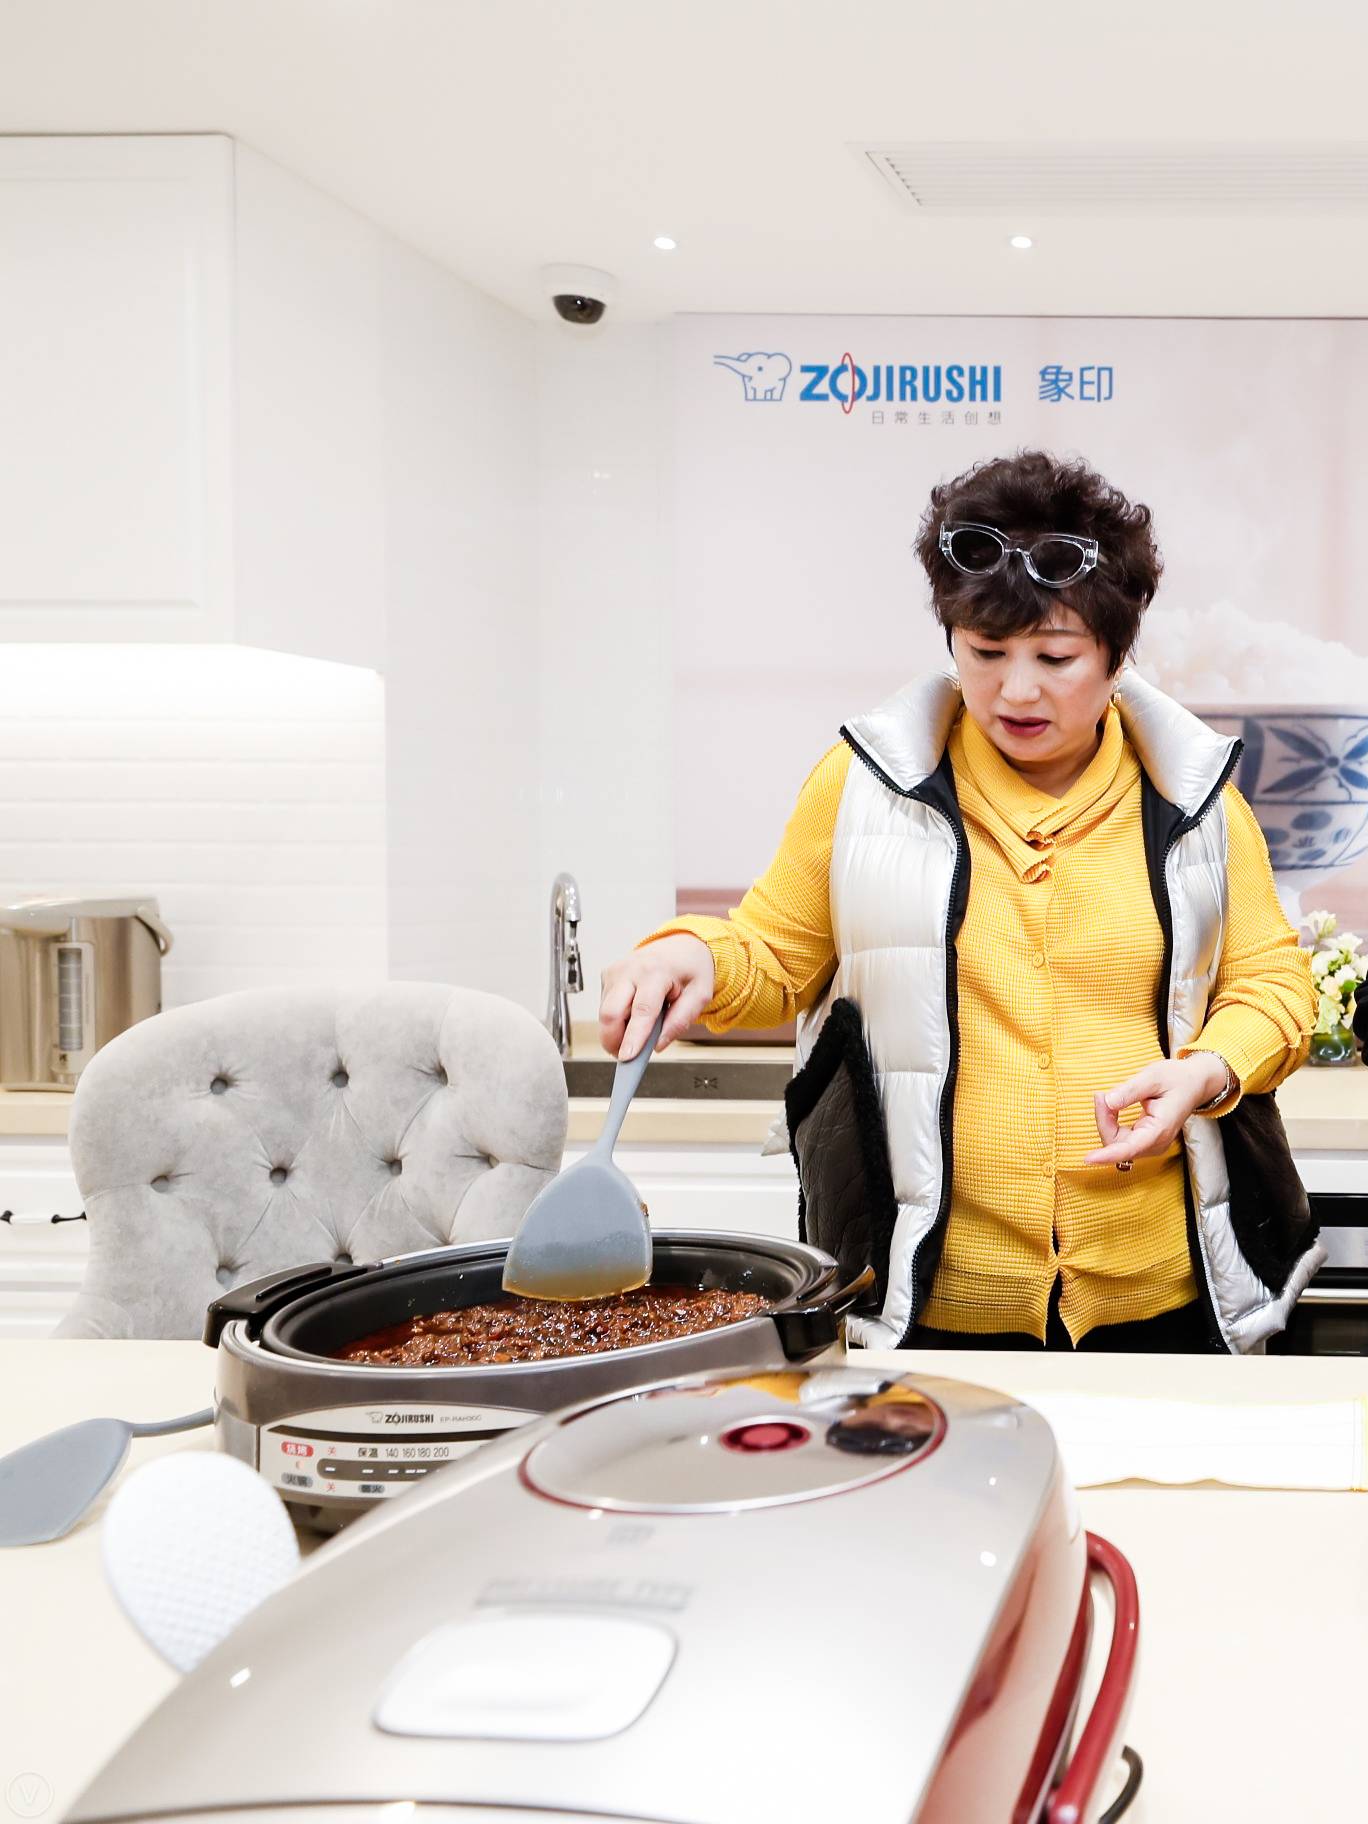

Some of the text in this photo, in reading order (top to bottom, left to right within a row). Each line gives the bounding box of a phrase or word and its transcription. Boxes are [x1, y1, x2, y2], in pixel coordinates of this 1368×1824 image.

[800, 352, 1002, 414] ZOJIRUSHI
[1037, 365, 1113, 402] 象印
[871, 410, 1002, 425] 日常生活创想
[385, 1413, 434, 1425] ZOJIRUSHI
[386, 1448, 399, 1458] 140
[434, 1447, 449, 1457] 200
